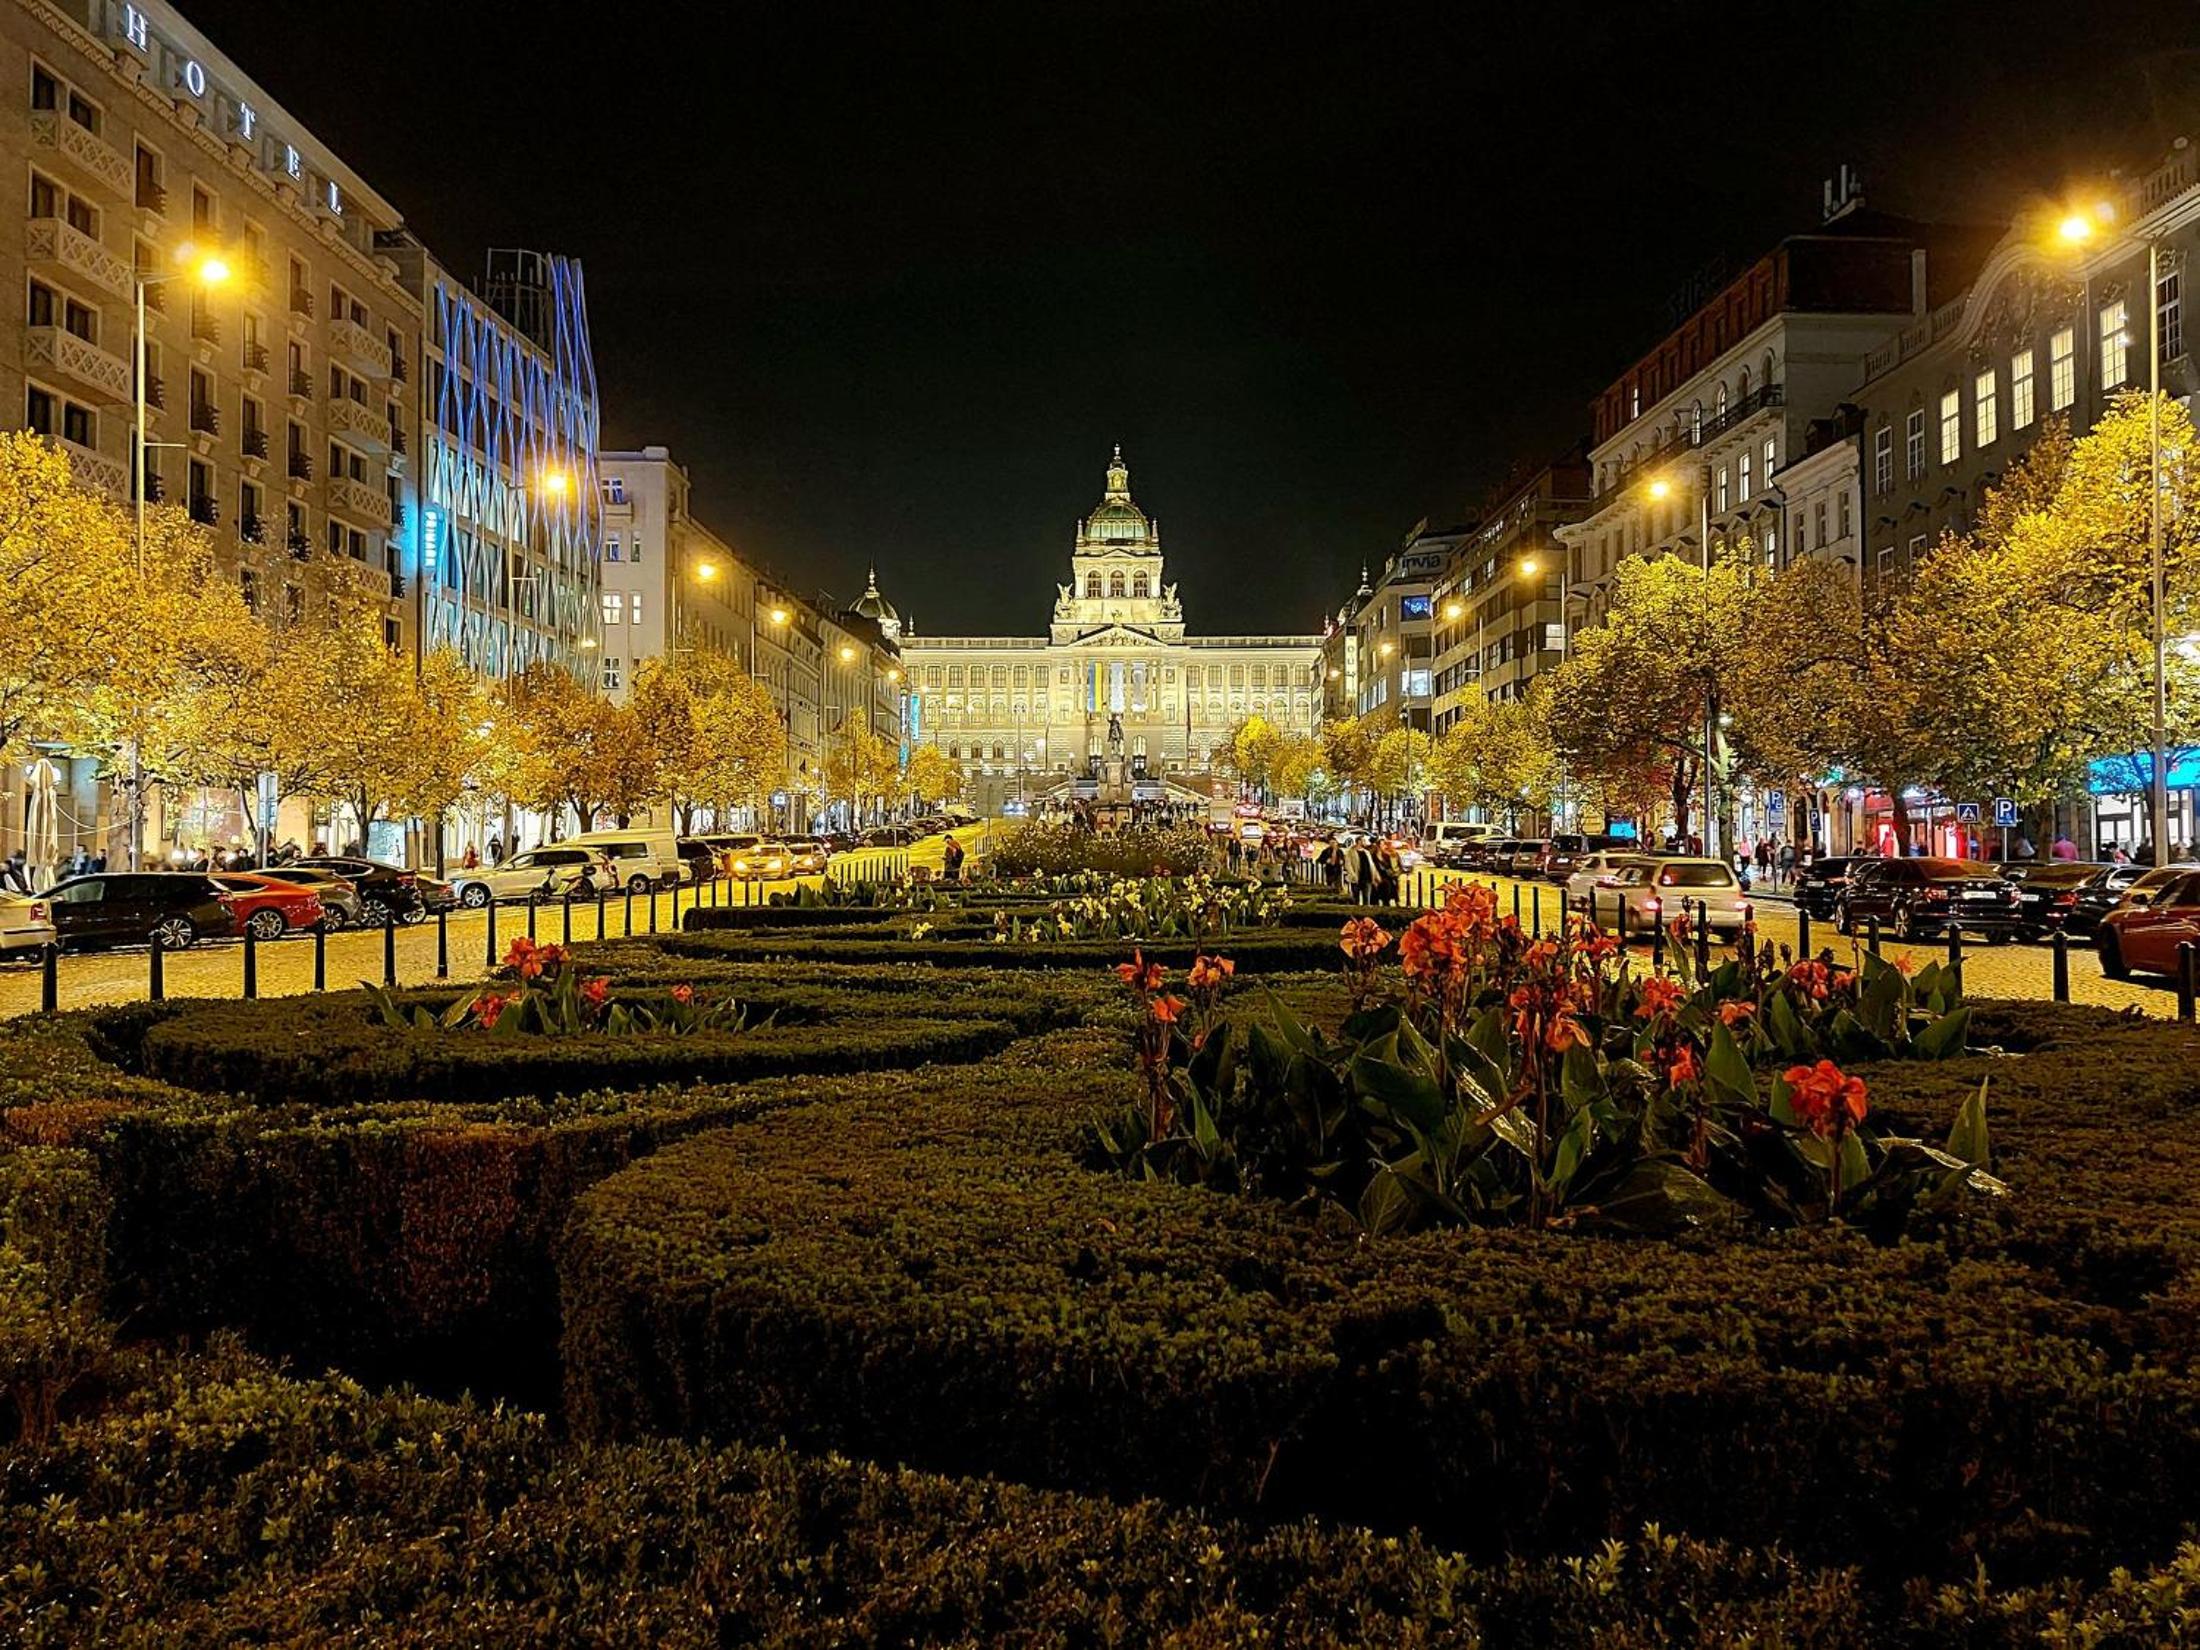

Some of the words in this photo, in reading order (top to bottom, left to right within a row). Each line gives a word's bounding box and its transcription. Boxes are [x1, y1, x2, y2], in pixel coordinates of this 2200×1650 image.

[125, 3, 342, 215] HOTEL
[1401, 554, 1441, 569] invia
[1999, 801, 2013, 818] P
